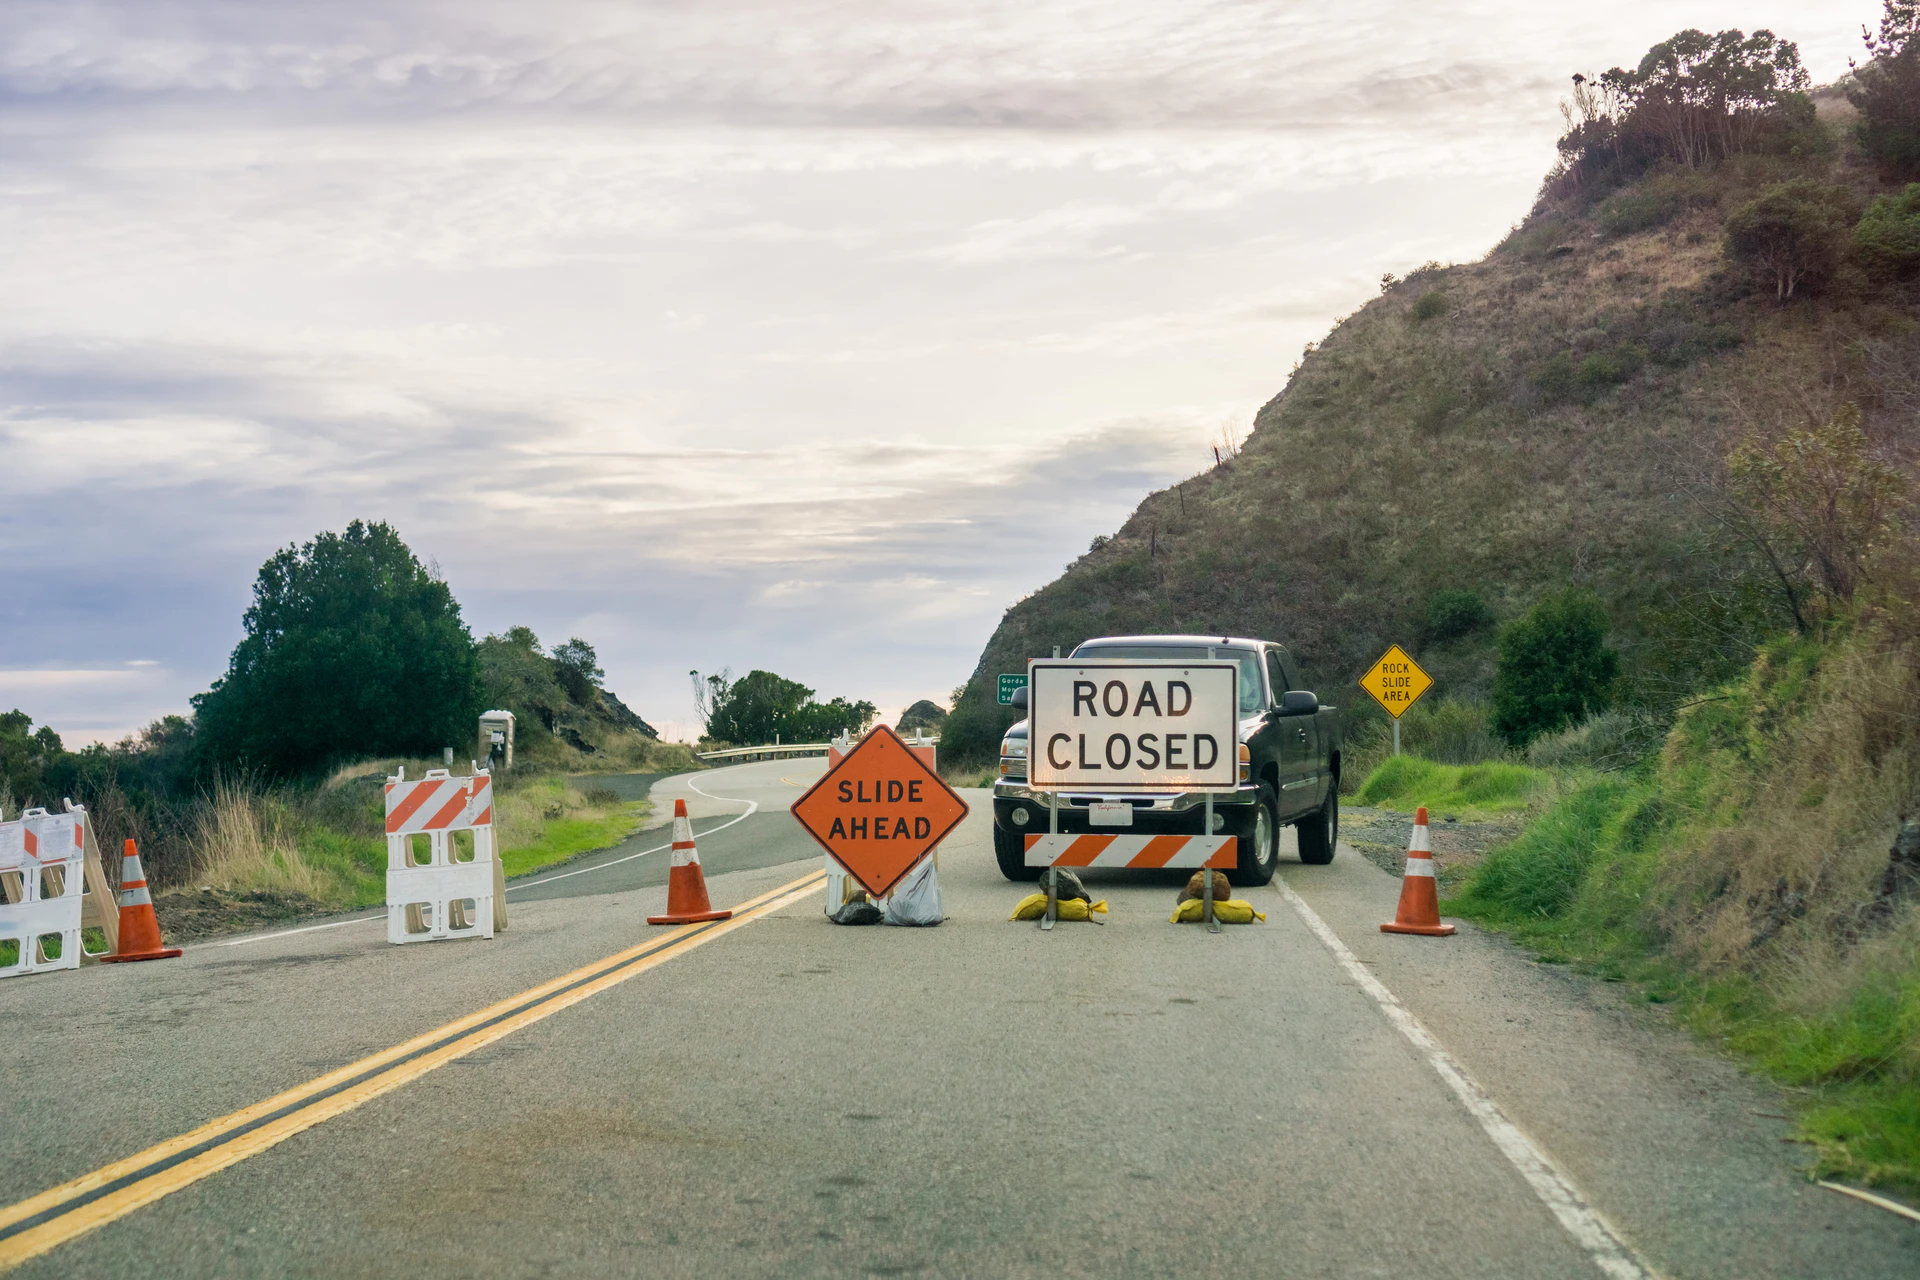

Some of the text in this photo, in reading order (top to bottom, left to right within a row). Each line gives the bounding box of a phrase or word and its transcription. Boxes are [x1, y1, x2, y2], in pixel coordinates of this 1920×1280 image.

[1382, 663, 1409, 673] ROCK
[1382, 677, 1411, 687] SLIDE
[1073, 680, 1192, 717] ROAD
[1383, 691, 1410, 701] AREA
[1047, 733, 1218, 770] CLOSED
[837, 780, 923, 803] SLIDE
[828, 817, 931, 839] AHEAD
